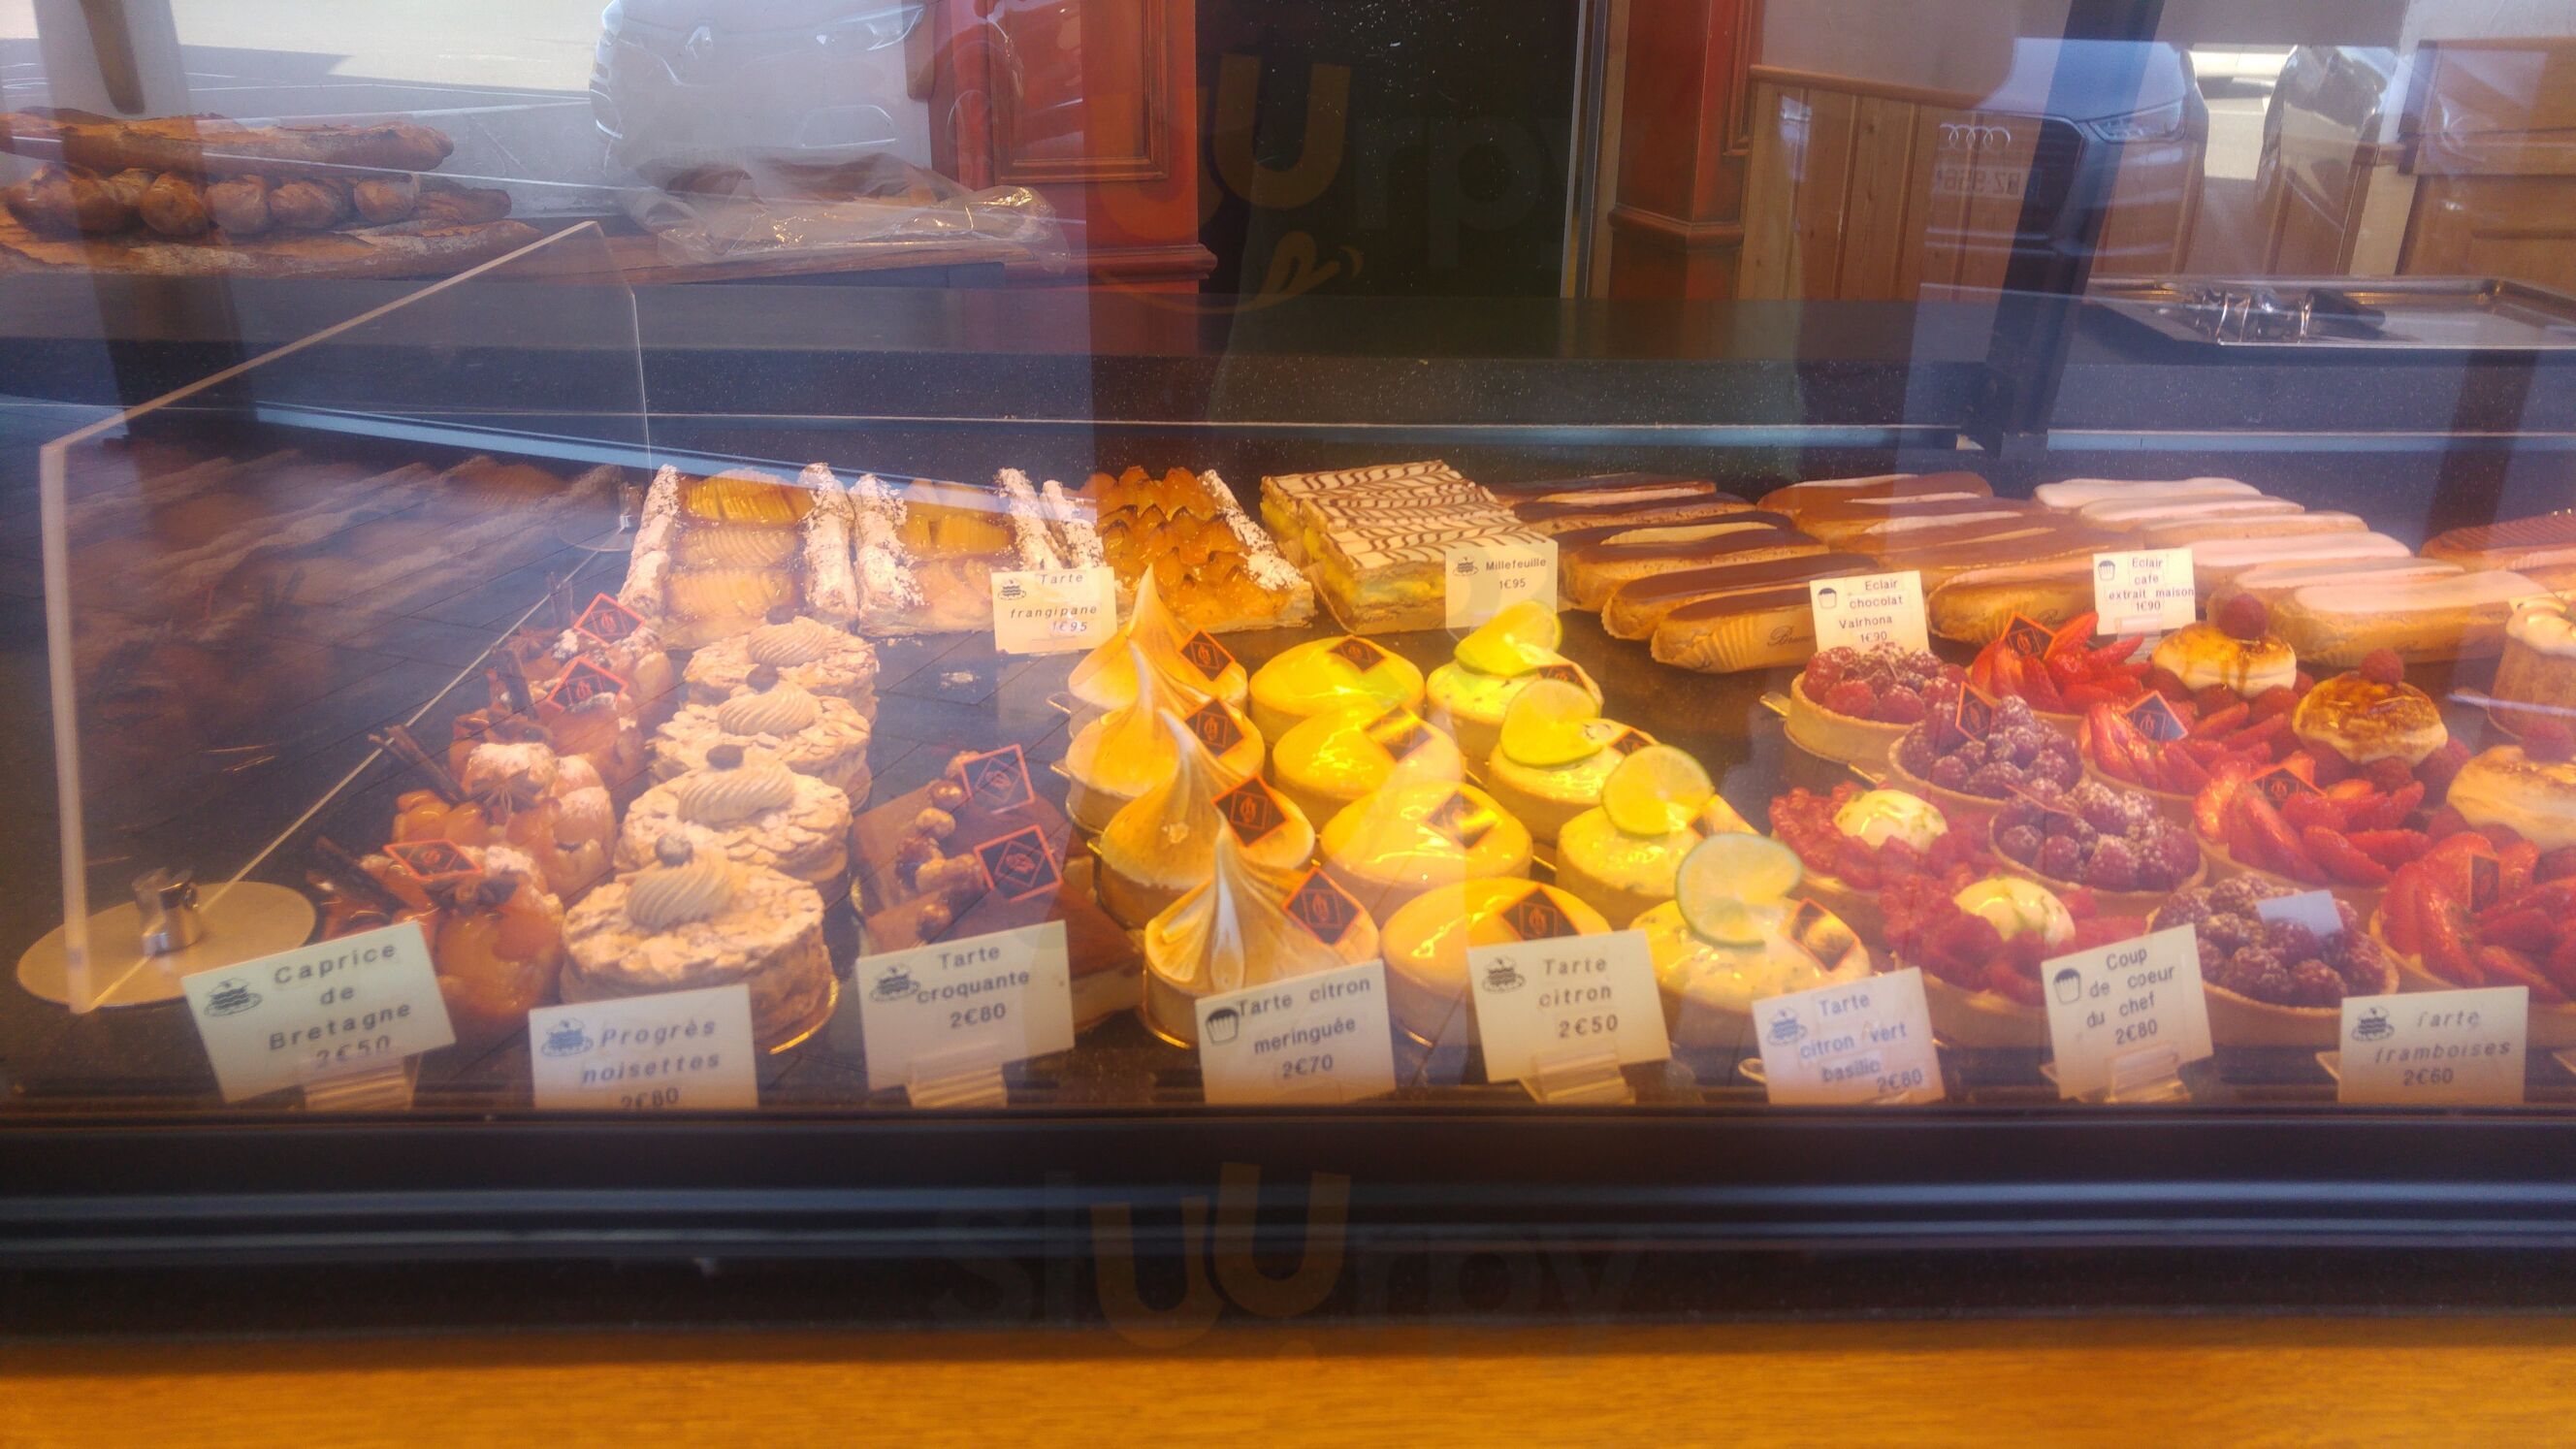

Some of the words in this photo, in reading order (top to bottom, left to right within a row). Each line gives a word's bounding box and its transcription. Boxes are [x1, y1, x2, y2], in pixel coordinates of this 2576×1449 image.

[1486, 558, 1547, 571] Millefeuille
[1040, 572, 1083, 585] Tarte
[1498, 578, 1527, 590] 1€95
[1864, 580, 1898, 591] Eclair
[1849, 596, 1903, 609] chocolat
[2109, 588, 2146, 600] extrait
[2155, 588, 2194, 598] maison
[2136, 600, 2161, 612] 1€90
[1011, 604, 1097, 619] frangipane
[1839, 615, 1892, 629] Valrhona
[1052, 621, 1087, 632] 1€95
[274, 943, 397, 984] Caprice
[937, 947, 1002, 970] Tarte
[1542, 957, 1609, 977] Tarte
[2106, 948, 2148, 971] Coup
[917, 970, 1031, 1005] croquante
[2088, 981, 2111, 998] de
[2126, 965, 2175, 989] coeur
[319, 984, 355, 1006] de
[1238, 994, 1294, 1018] Tarte
[1309, 978, 1371, 1004] citron
[1538, 984, 1613, 1009] citron
[1819, 993, 1870, 1017] Tarte
[949, 1002, 1007, 1030] 2€80
[2086, 1010, 2107, 1028] du
[2118, 990, 2156, 1017] chef
[268, 1003, 411, 1051] Bretagne
[600, 1018, 717, 1048] Progrès
[1253, 1016, 1356, 1056] meringuée
[1558, 1014, 1620, 1040] 2€50
[2114, 1018, 2159, 1046] 2€80
[1799, 1035, 1855, 1060] citron
[1869, 1022, 1908, 1044] vert
[2374, 1042, 2512, 1064] framboises
[582, 1053, 721, 1084] noisettes
[1281, 1053, 1335, 1079] 2€70
[1820, 1059, 1881, 1083] basilic
[1876, 1068, 1923, 1094] 2€80
